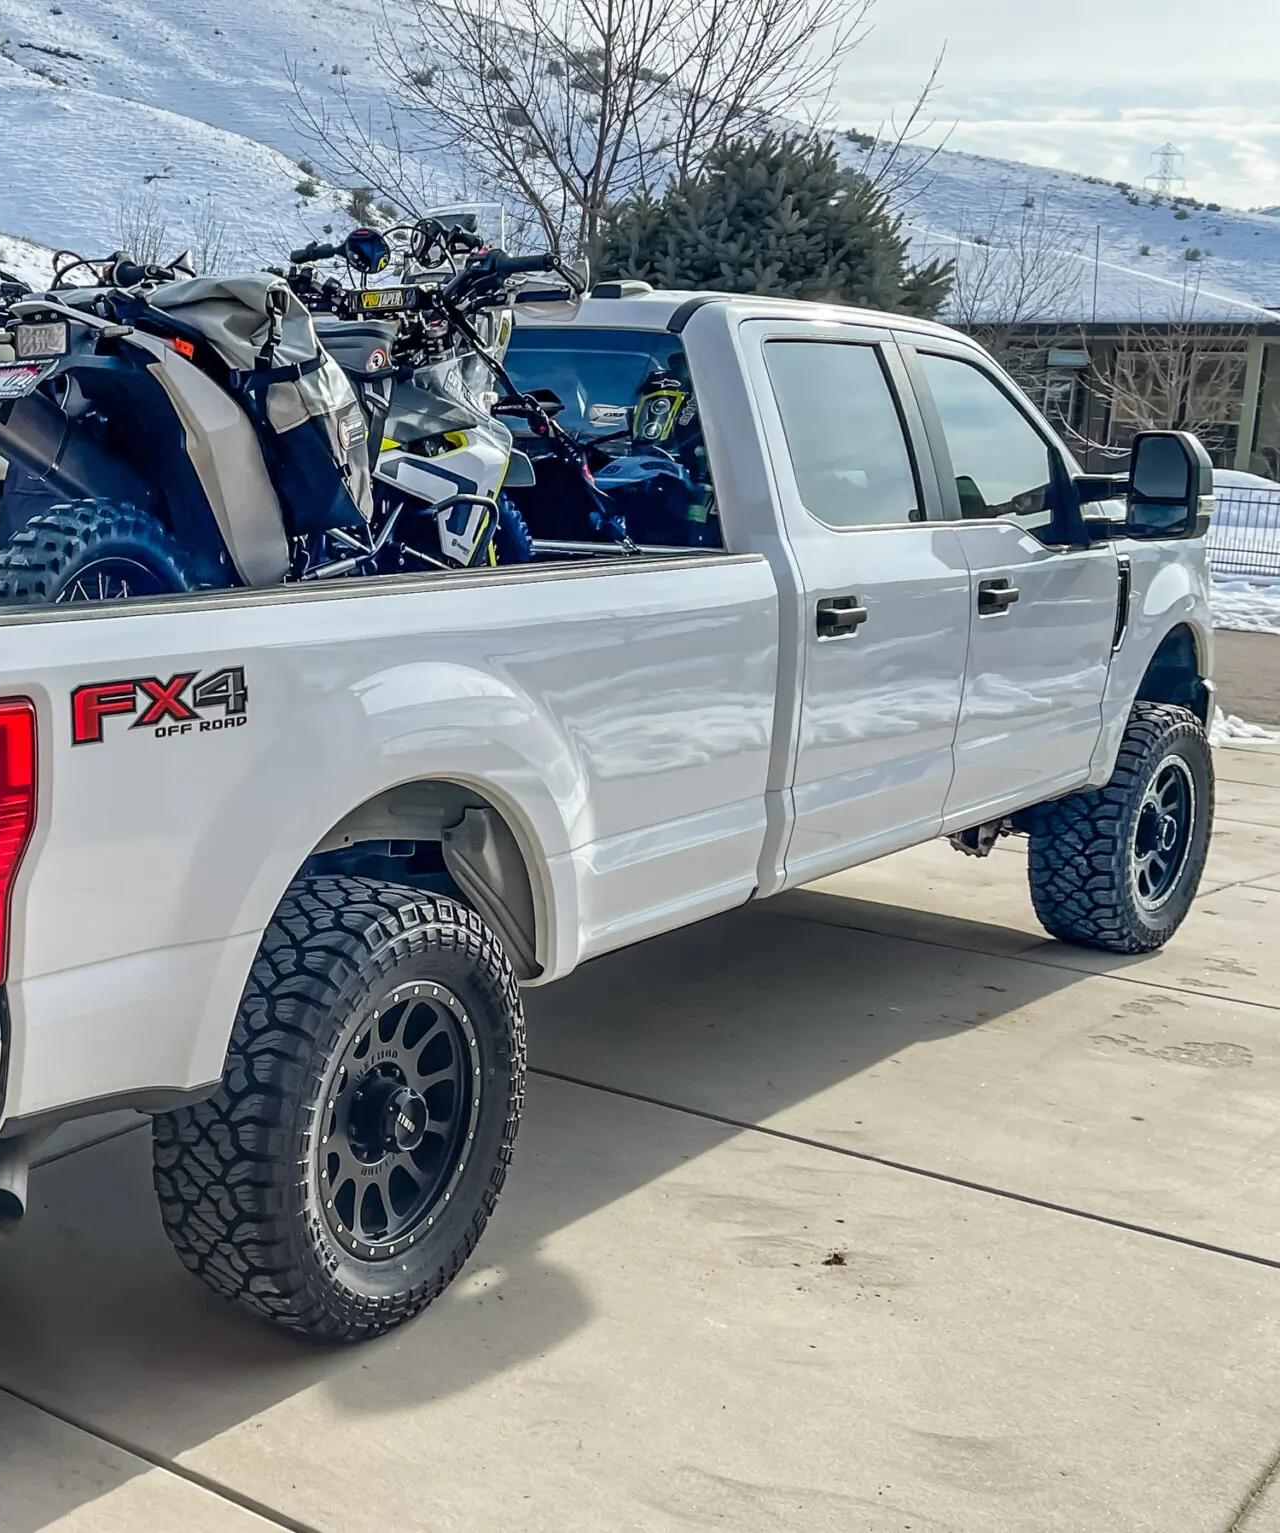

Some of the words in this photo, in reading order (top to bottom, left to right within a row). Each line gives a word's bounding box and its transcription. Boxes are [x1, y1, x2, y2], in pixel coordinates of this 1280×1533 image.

[70, 664, 248, 746] FX4
[154, 723, 193, 739] OFF
[199, 716, 248, 733] ROAD
